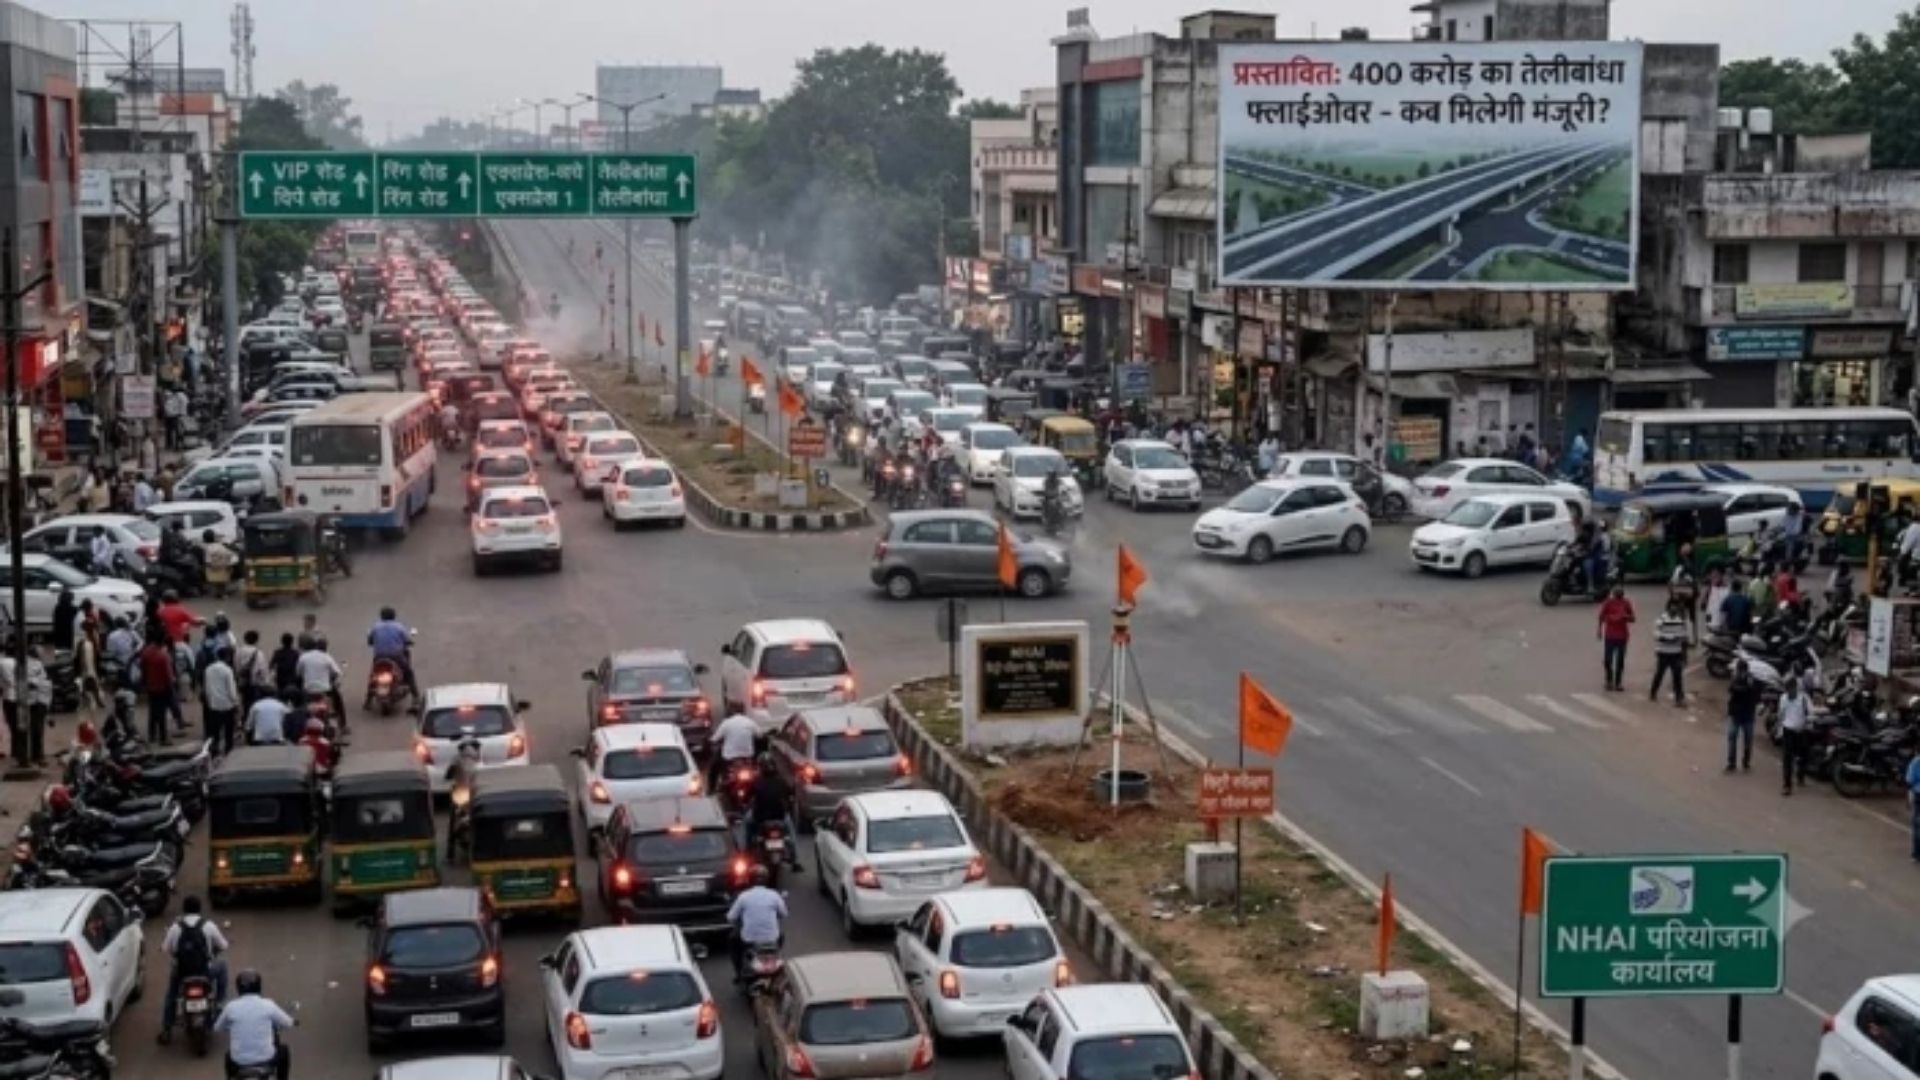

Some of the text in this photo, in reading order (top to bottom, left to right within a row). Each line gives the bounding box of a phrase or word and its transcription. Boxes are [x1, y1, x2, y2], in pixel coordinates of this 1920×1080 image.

[1233, 53, 1626, 91] प्रस्तावित: 400 करोड़ का तेलीबांधा
[1246, 92, 1372, 129] फ्लाईओवर
[1448, 92, 1525, 124] मिलेगी
[1532, 92, 1611, 132] मंजूरी?
[271, 159, 346, 181] VIP रोड
[310, 186, 342, 207] रोड
[417, 186, 449, 207] रोड
[563, 191, 573, 208] 1
[1556, 918, 1769, 952] NHAI परियोजना
[1610, 952, 1716, 984] कार्यालय
